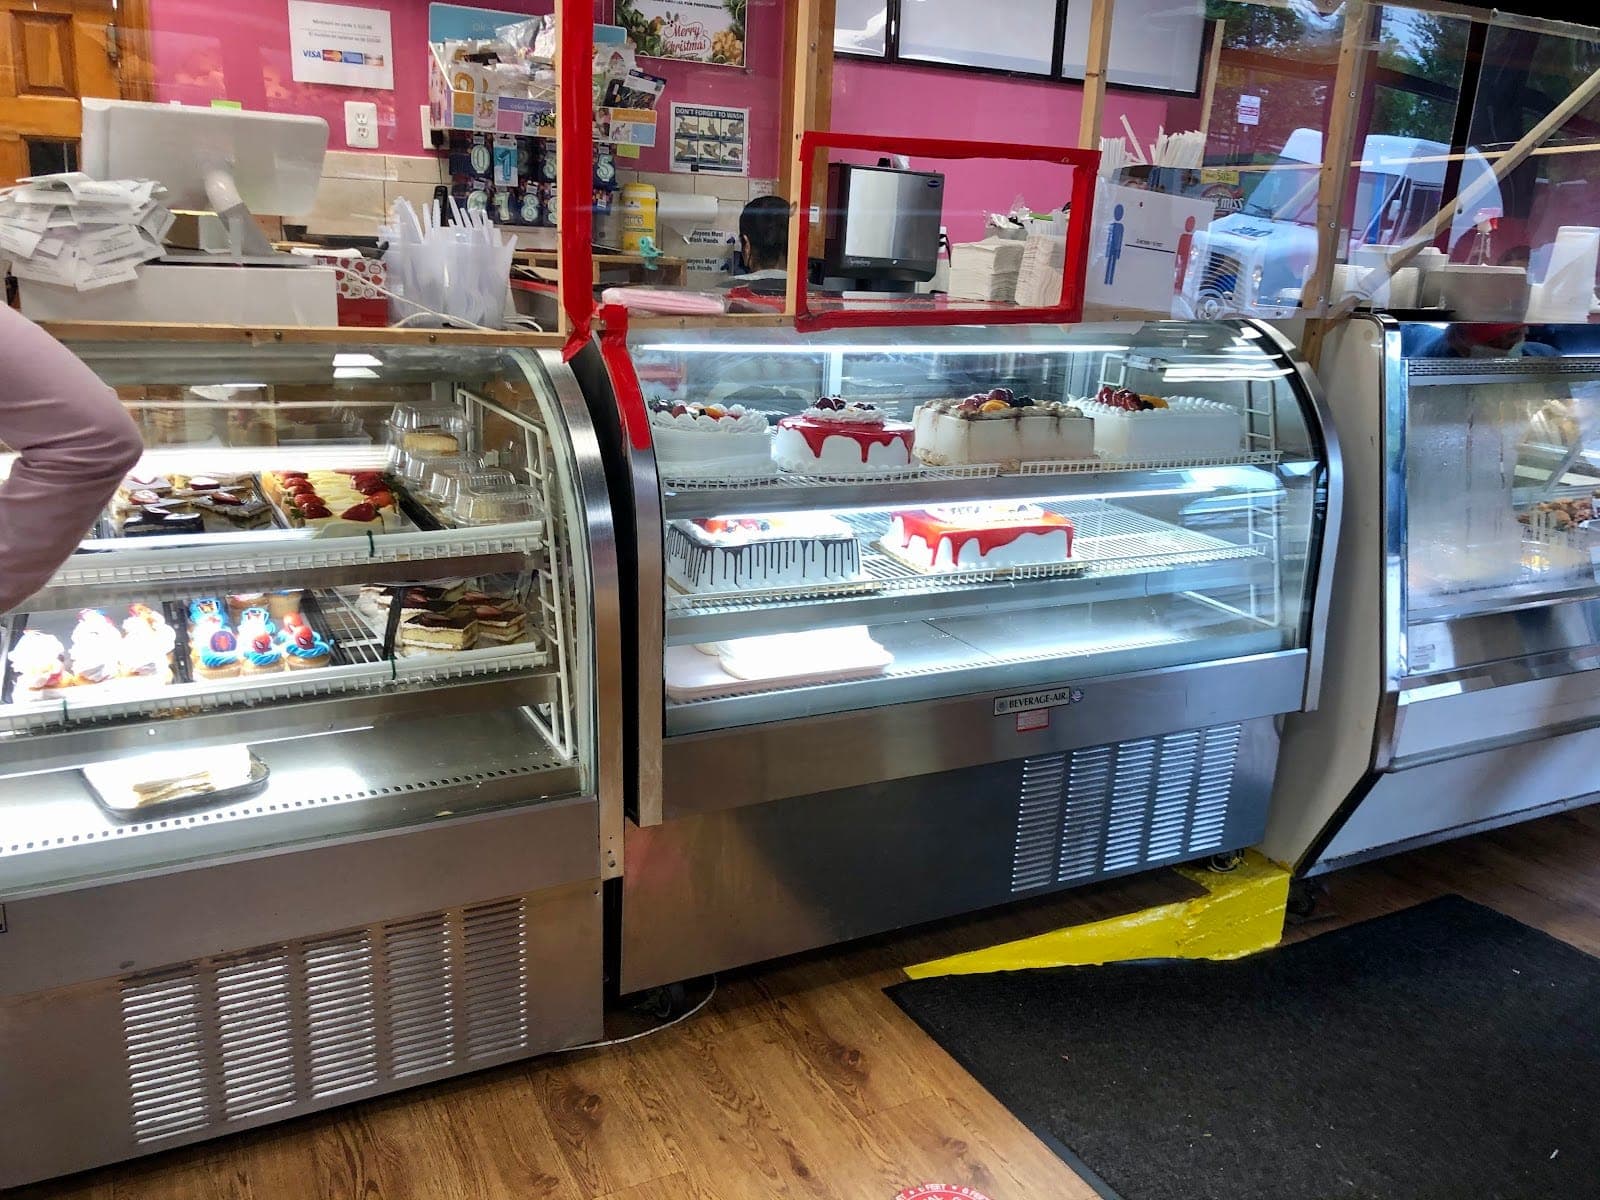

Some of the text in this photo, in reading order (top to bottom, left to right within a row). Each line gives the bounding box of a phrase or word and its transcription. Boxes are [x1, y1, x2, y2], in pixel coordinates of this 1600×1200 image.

[672, 24, 701, 39] Merry
[664, 39, 706, 52] Christmas
[302, 50, 321, 59] VISA
[675, 107, 694, 115] DON'T
[695, 109, 717, 117] FORGET
[727, 112, 744, 120] WASH
[596, 154, 615, 182] 5
[521, 193, 540, 222] 8
[1011, 692, 1066, 708] BEVERAGE-AIR
